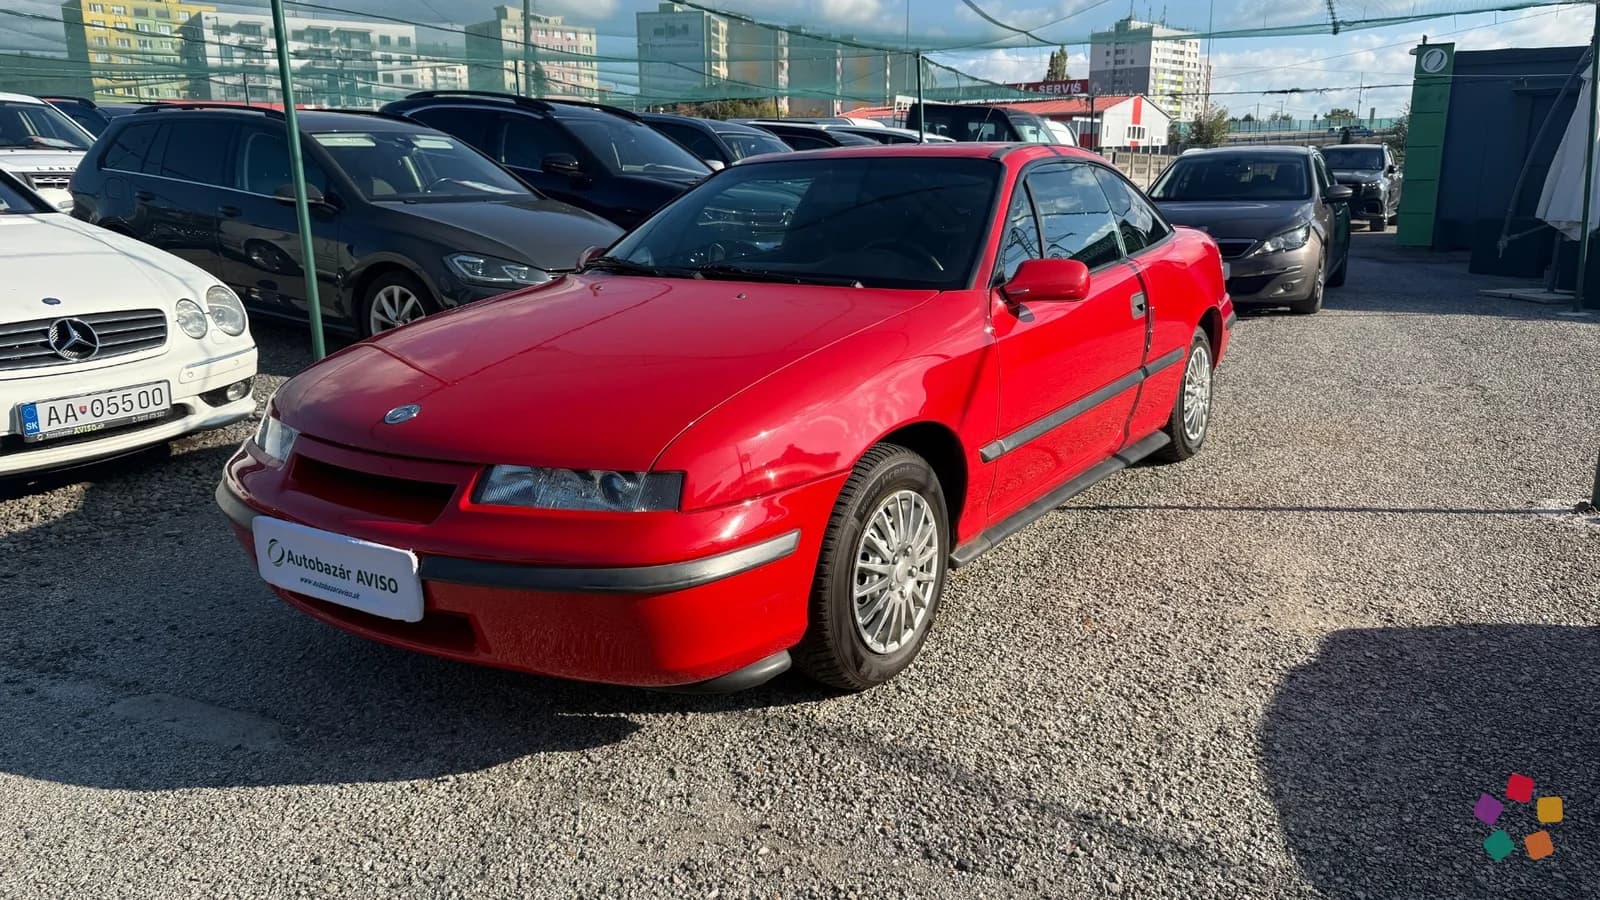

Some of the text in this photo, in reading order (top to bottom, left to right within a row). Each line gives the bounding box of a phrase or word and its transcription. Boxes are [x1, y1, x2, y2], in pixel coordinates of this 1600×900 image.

[1038, 82, 1081, 95] SERVIS
[47, 403, 78, 426] AA
[26, 421, 38, 430] SK
[287, 549, 399, 594] Autobazár AVISO
